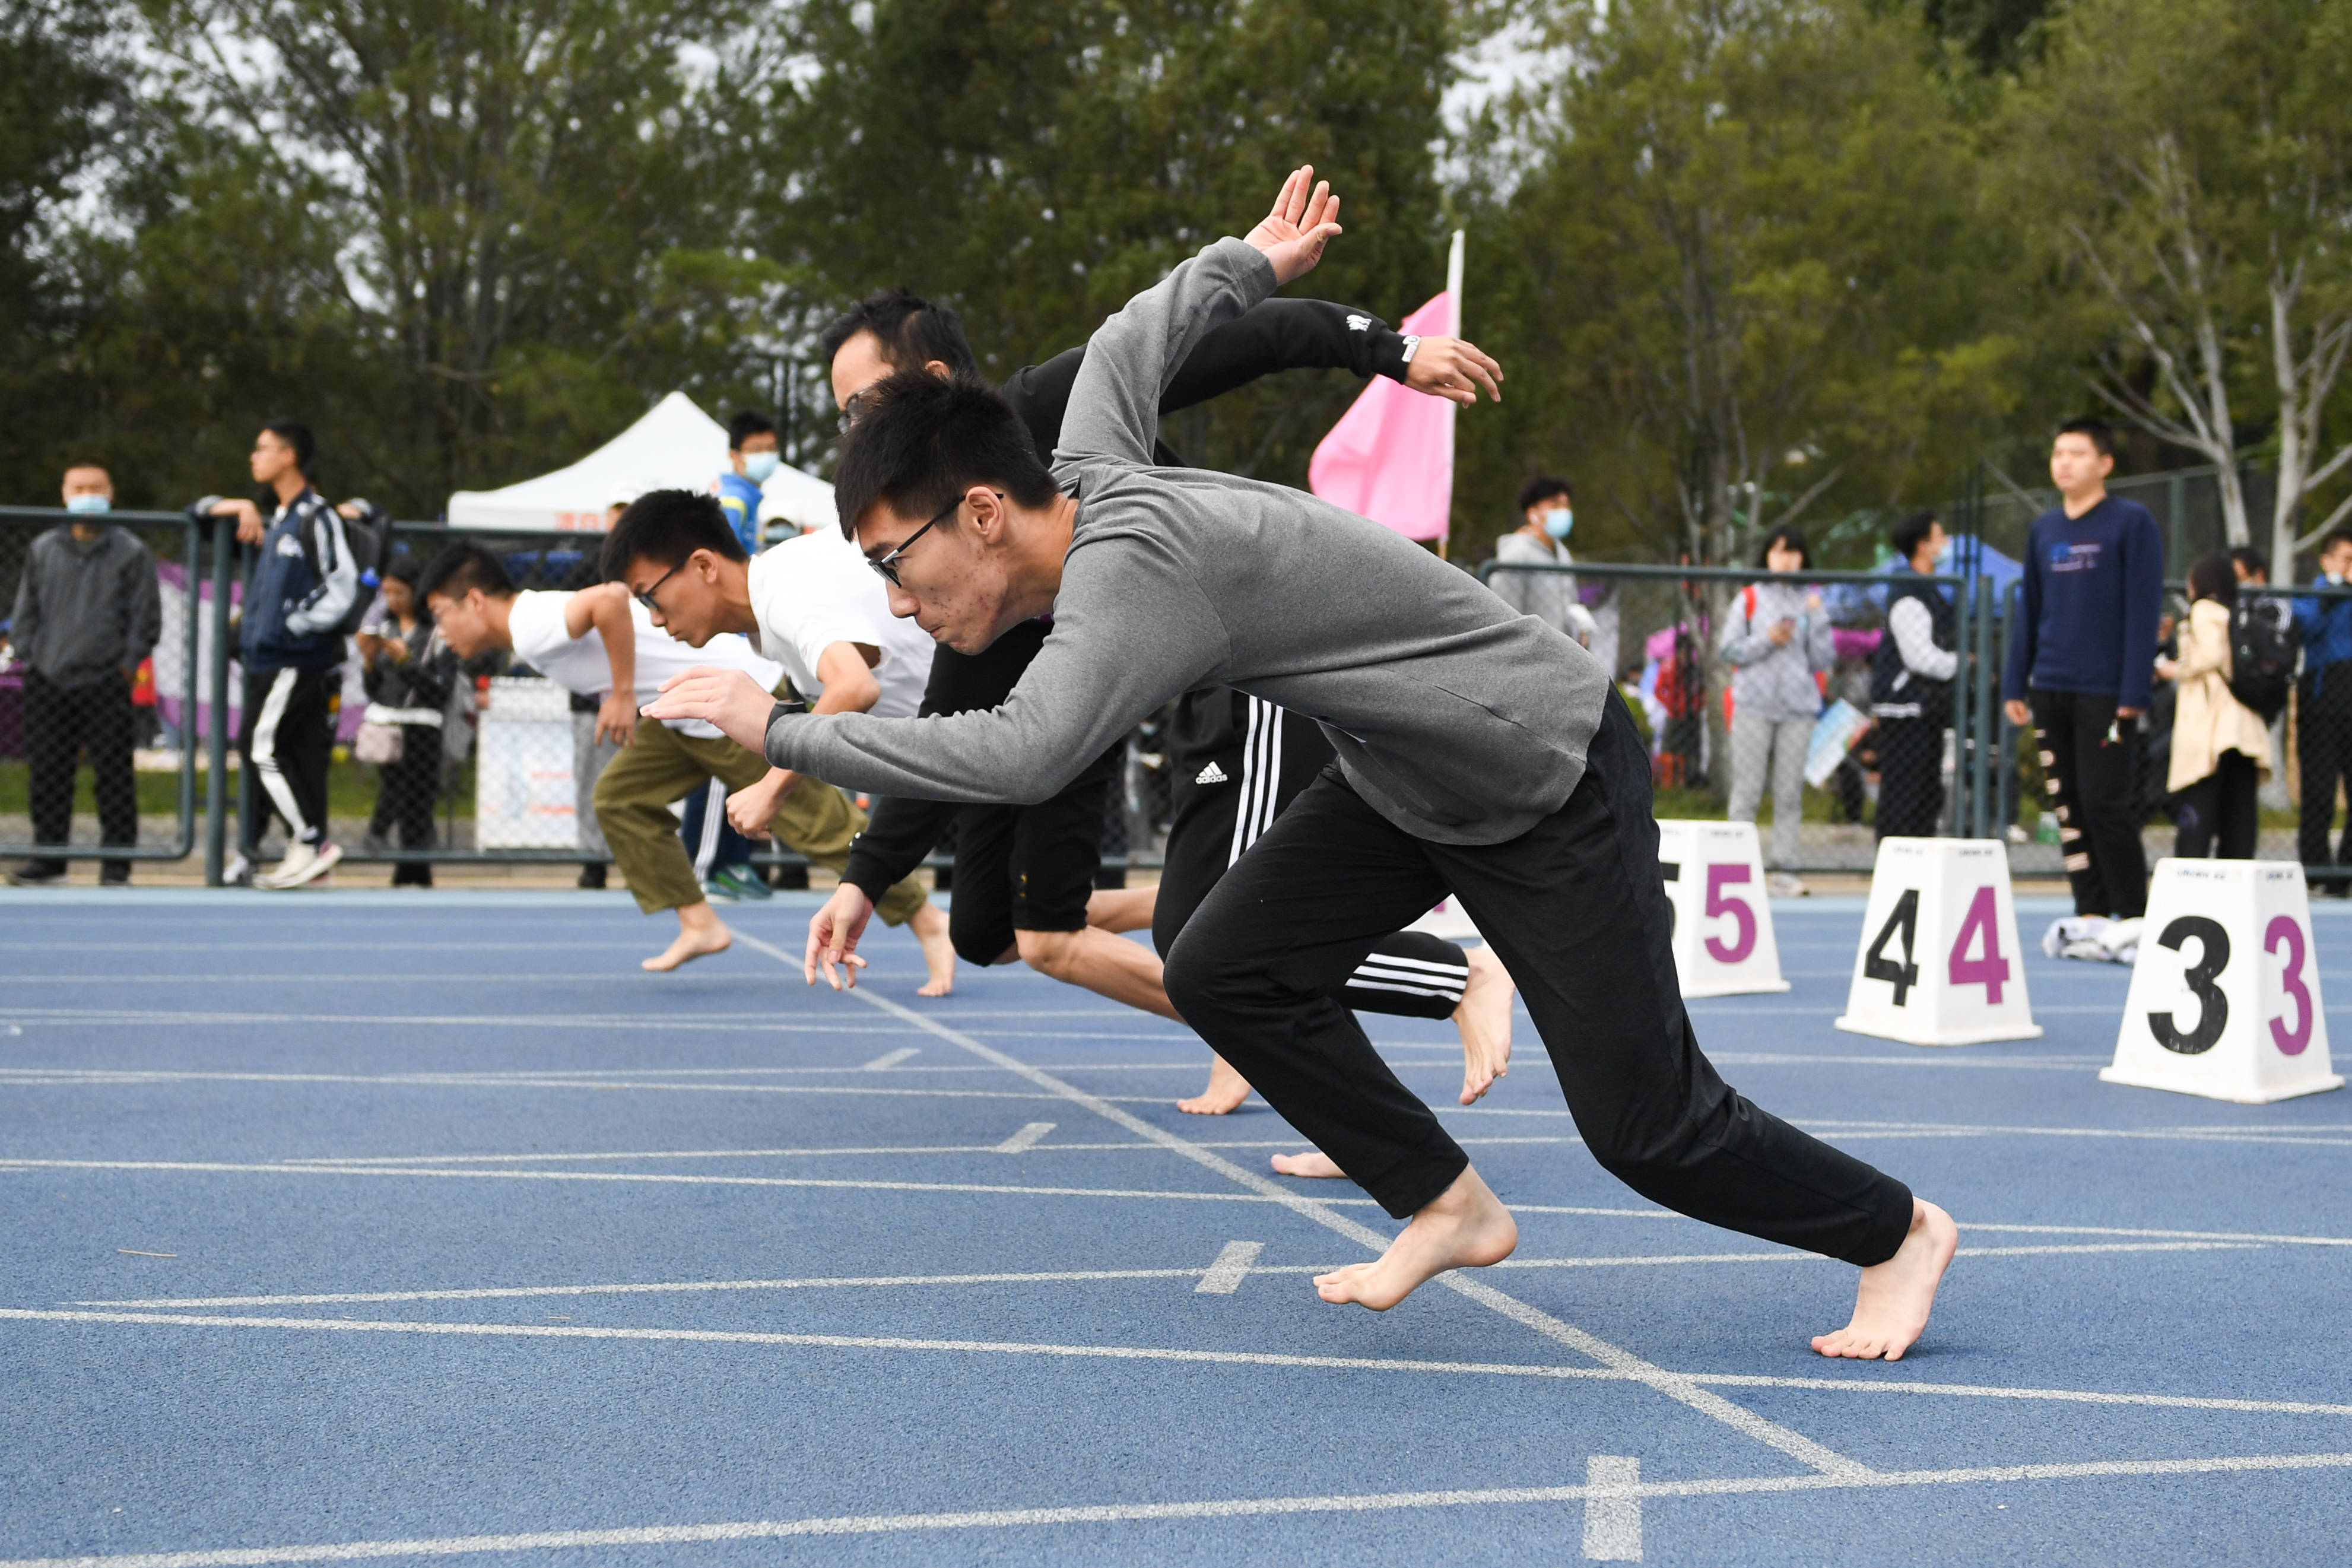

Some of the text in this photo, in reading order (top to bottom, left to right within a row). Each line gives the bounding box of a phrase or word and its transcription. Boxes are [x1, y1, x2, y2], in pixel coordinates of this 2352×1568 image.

[1195, 774, 1228, 784] adidas
[1705, 864, 1757, 963] 5
[1864, 888, 1919, 1007] 4
[1948, 887, 2010, 1004] 4
[2147, 916, 2230, 1055] 3
[2264, 916, 2313, 1055] 3
